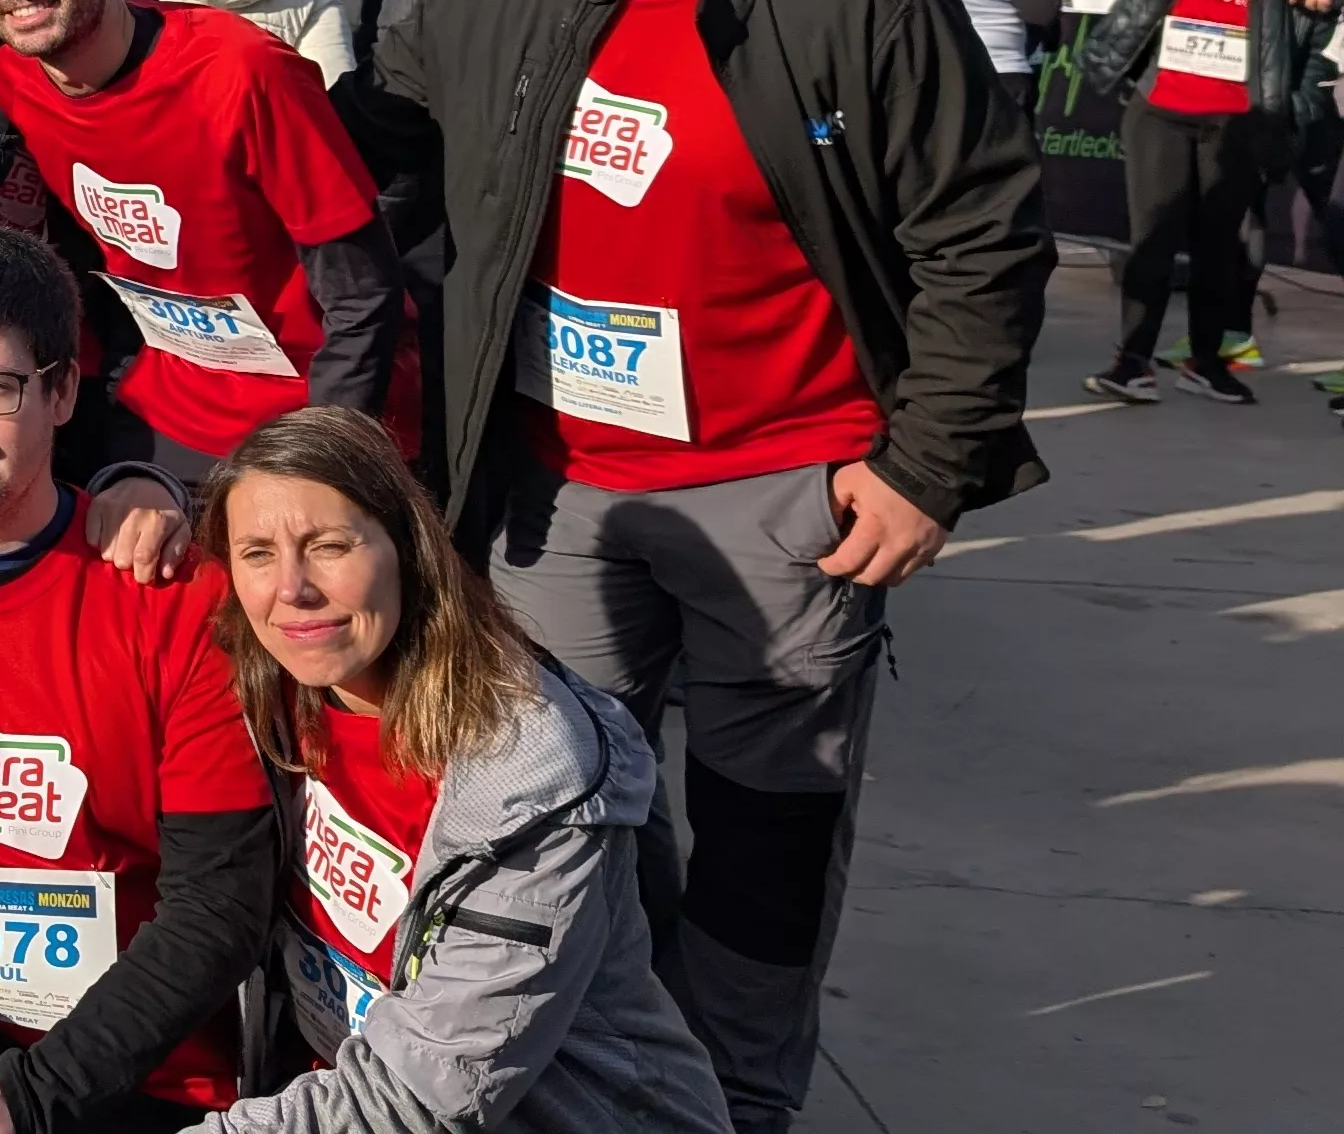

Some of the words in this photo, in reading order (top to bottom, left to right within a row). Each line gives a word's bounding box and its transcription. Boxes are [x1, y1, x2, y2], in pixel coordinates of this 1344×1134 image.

[567, 134, 648, 176] meat
[103, 215, 168, 245] meat
[140, 295, 240, 335] 3081
[609, 313, 656, 330] MONZÓN
[169, 323, 225, 343] ARTURO
[541, 315, 647, 372] 3087
[29, 825, 62, 839] Group
[305, 835, 382, 923] meat
[7, 904, 27, 912] MEAT
[38, 889, 90, 908] MONZÓN
[16, 1016, 38, 1024] MEAT
